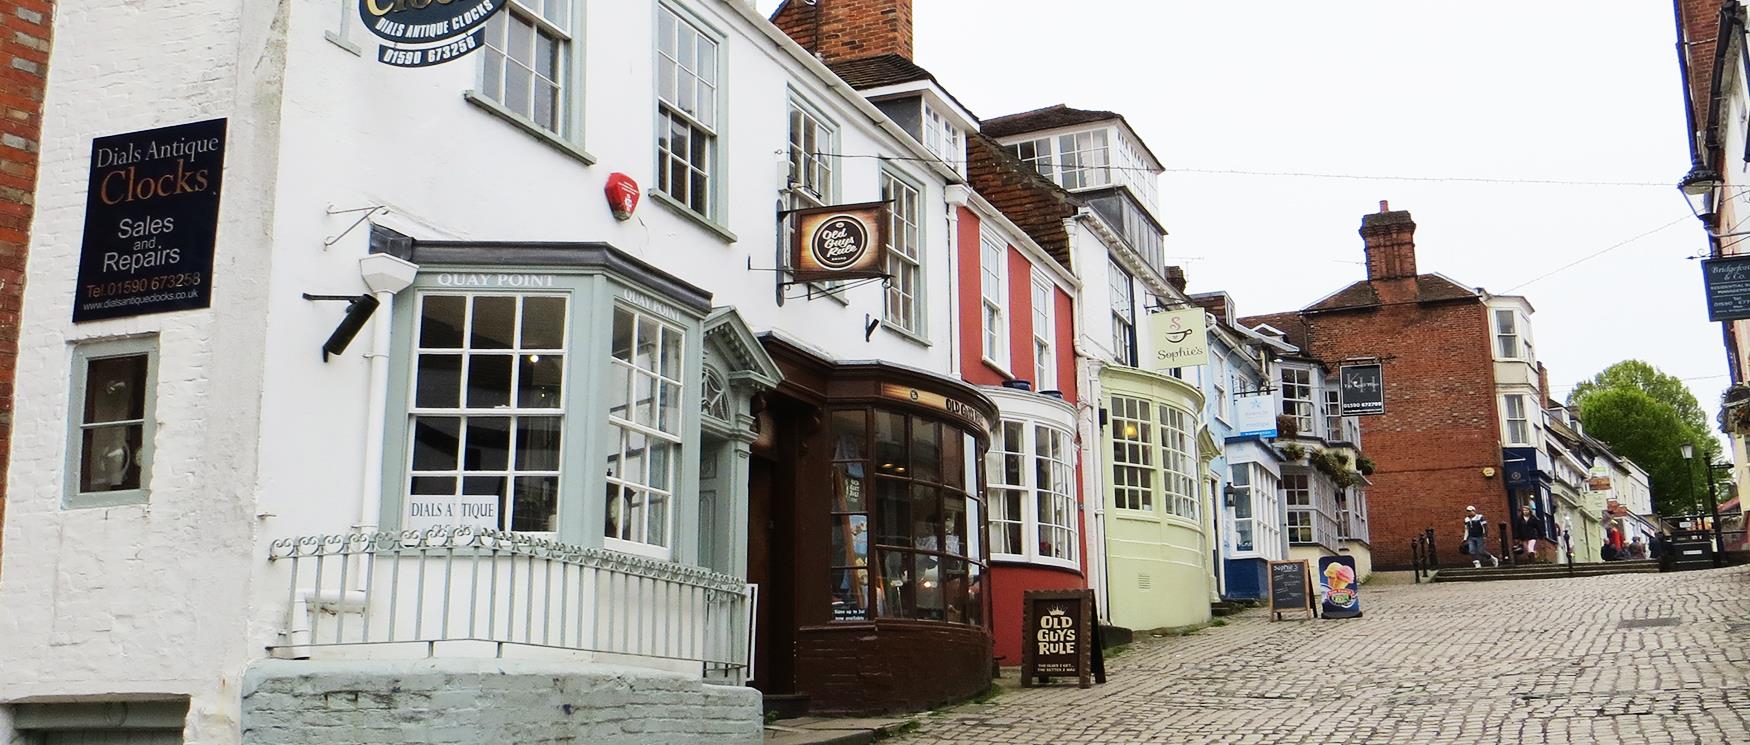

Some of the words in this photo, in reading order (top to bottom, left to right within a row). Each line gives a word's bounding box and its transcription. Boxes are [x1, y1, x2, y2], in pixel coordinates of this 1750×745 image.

[375, 17, 405, 37] DIALS
[405, 21, 449, 38] ANTIQUE
[452, 0, 494, 31] CLOCKS
[383, 49, 422, 64] 01590
[427, 36, 476, 63] 673258
[97, 142, 142, 168] Dials
[145, 137, 219, 162] Antique
[101, 158, 209, 205] Clocks
[118, 215, 175, 239] Sales
[822, 228, 848, 240] Old
[133, 237, 156, 250] and
[824, 236, 855, 249] Guys
[827, 245, 858, 258] Rule
[103, 246, 180, 273] Repairs
[151, 271, 201, 290] 673258
[437, 273, 491, 287] QUAY
[499, 274, 555, 287] POINT
[83, 289, 199, 311] www.dialsantiqueclocks.co.uk
[624, 289, 650, 309] QUAY
[653, 301, 680, 321] POINT
[1157, 346, 1203, 361] Sophie's
[945, 398, 960, 413] OLD
[411, 503, 442, 517] DIALS
[445, 503, 494, 519] ATIQUE
[1040, 615, 1073, 629] OLD
[1037, 629, 1076, 642] GUYS
[1038, 642, 1075, 655] RULE
